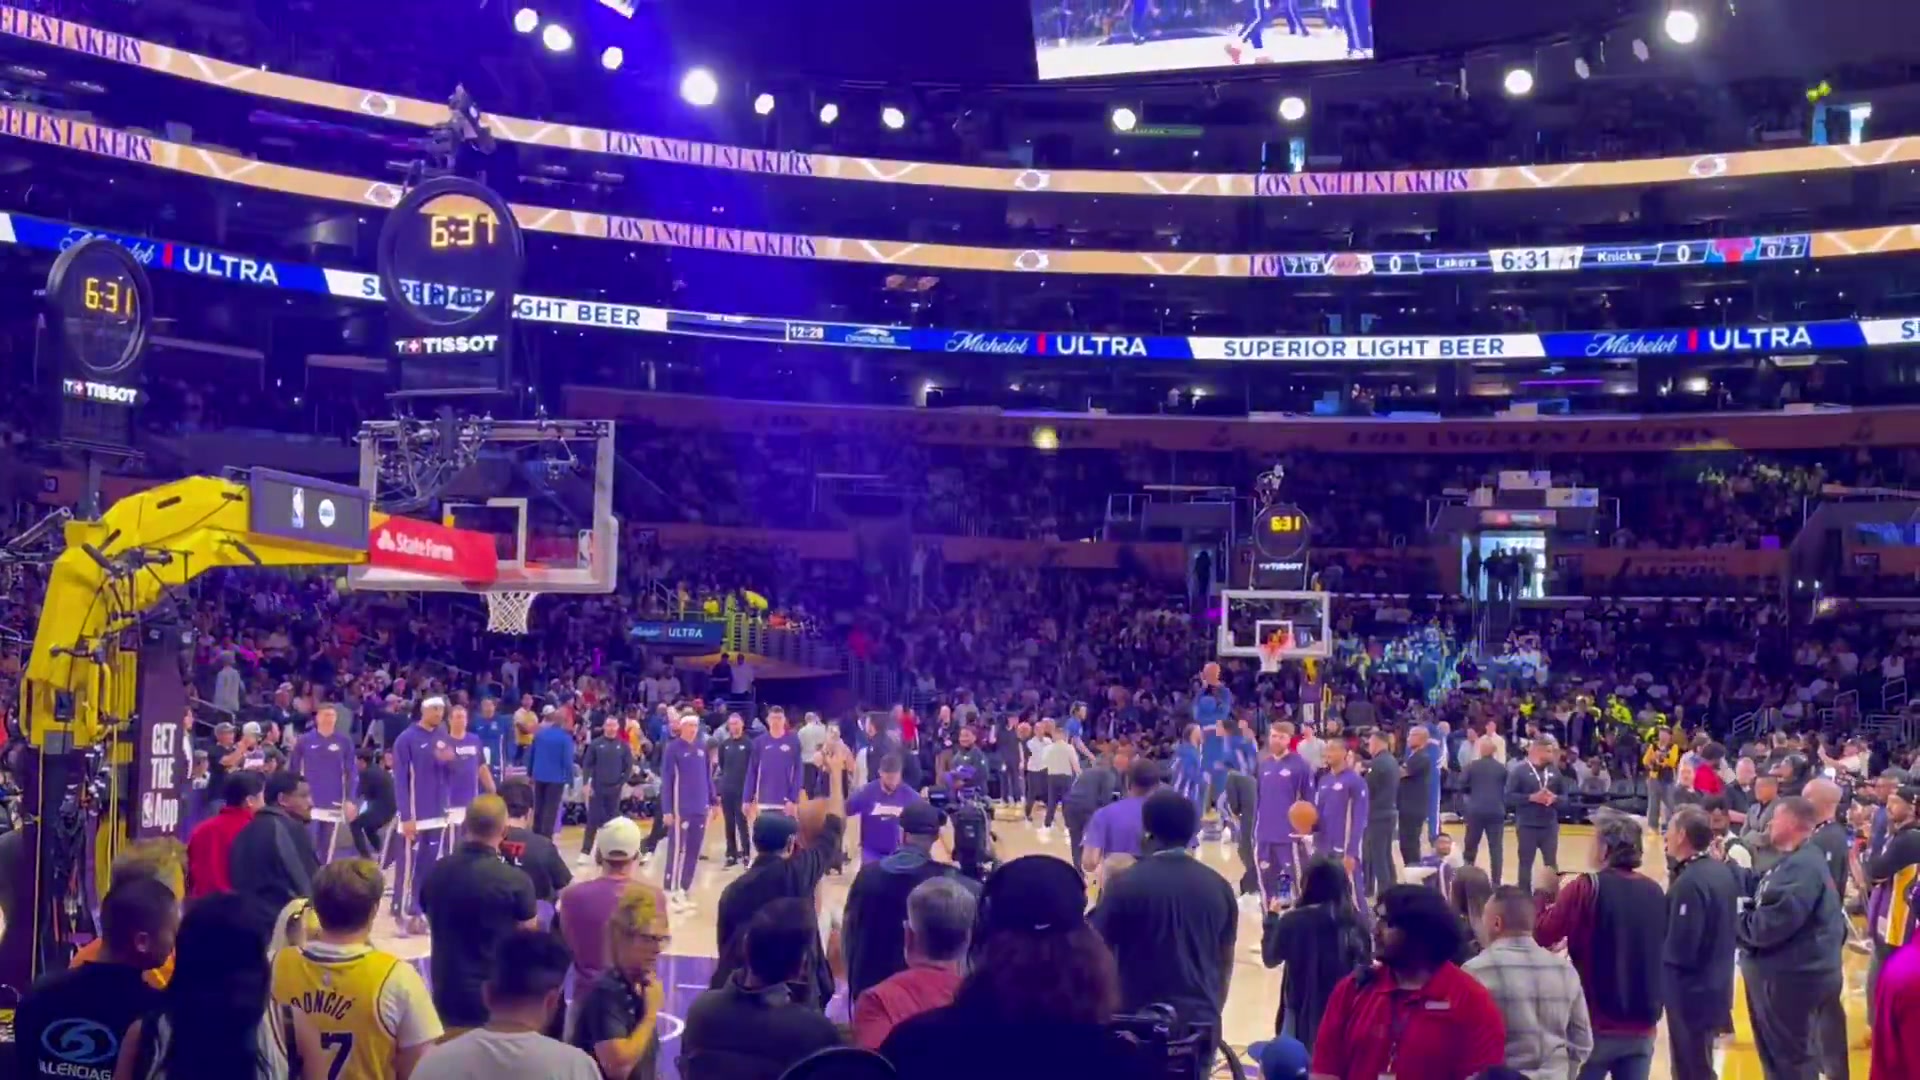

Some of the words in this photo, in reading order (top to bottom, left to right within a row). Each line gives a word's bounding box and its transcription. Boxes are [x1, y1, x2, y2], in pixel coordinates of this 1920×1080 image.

[605, 131, 643, 155] LOS
[650, 138, 735, 168] ANGELES
[738, 147, 814, 176] LAKERS
[1254, 172, 1292, 196] LOS
[1299, 170, 1386, 195] ANGELES
[1389, 168, 1469, 194] LAKERS
[606, 215, 645, 240] LOS
[651, 222, 736, 251] ANGELES
[739, 230, 816, 258] LAKERS
[183, 248, 279, 285] ULTRA
[1389, 255, 1402, 273] 0
[1436, 258, 1478, 268] Lakers
[1501, 250, 1550, 270] 6:31
[1597, 249, 1641, 262] Knicks
[1676, 245, 1690, 262] 0
[85, 277, 132, 317] 6:31
[513, 297, 567, 319] GHT
[577, 304, 641, 327] BEER
[424, 335, 498, 353] TISSOT
[945, 331, 1028, 354] Michelob
[1057, 335, 1147, 356] ULTRA
[1223, 340, 1347, 357] SUPERIOR
[1357, 339, 1429, 357] LIGHT
[1439, 337, 1505, 356] BEER
[1586, 333, 1680, 356] Michelob
[1708, 327, 1812, 350] ULTRA
[85, 382, 137, 402] TISSOT
[395, 531, 427, 557] State
[426, 537, 455, 562] Farm
[668, 627, 703, 638] ULTRA
[152, 722, 177, 755] GET
[150, 757, 175, 790] THE
[154, 792, 178, 832] App
[39, 1059, 112, 1080] ALENCIAG
[320, 1031, 354, 1080] 7
